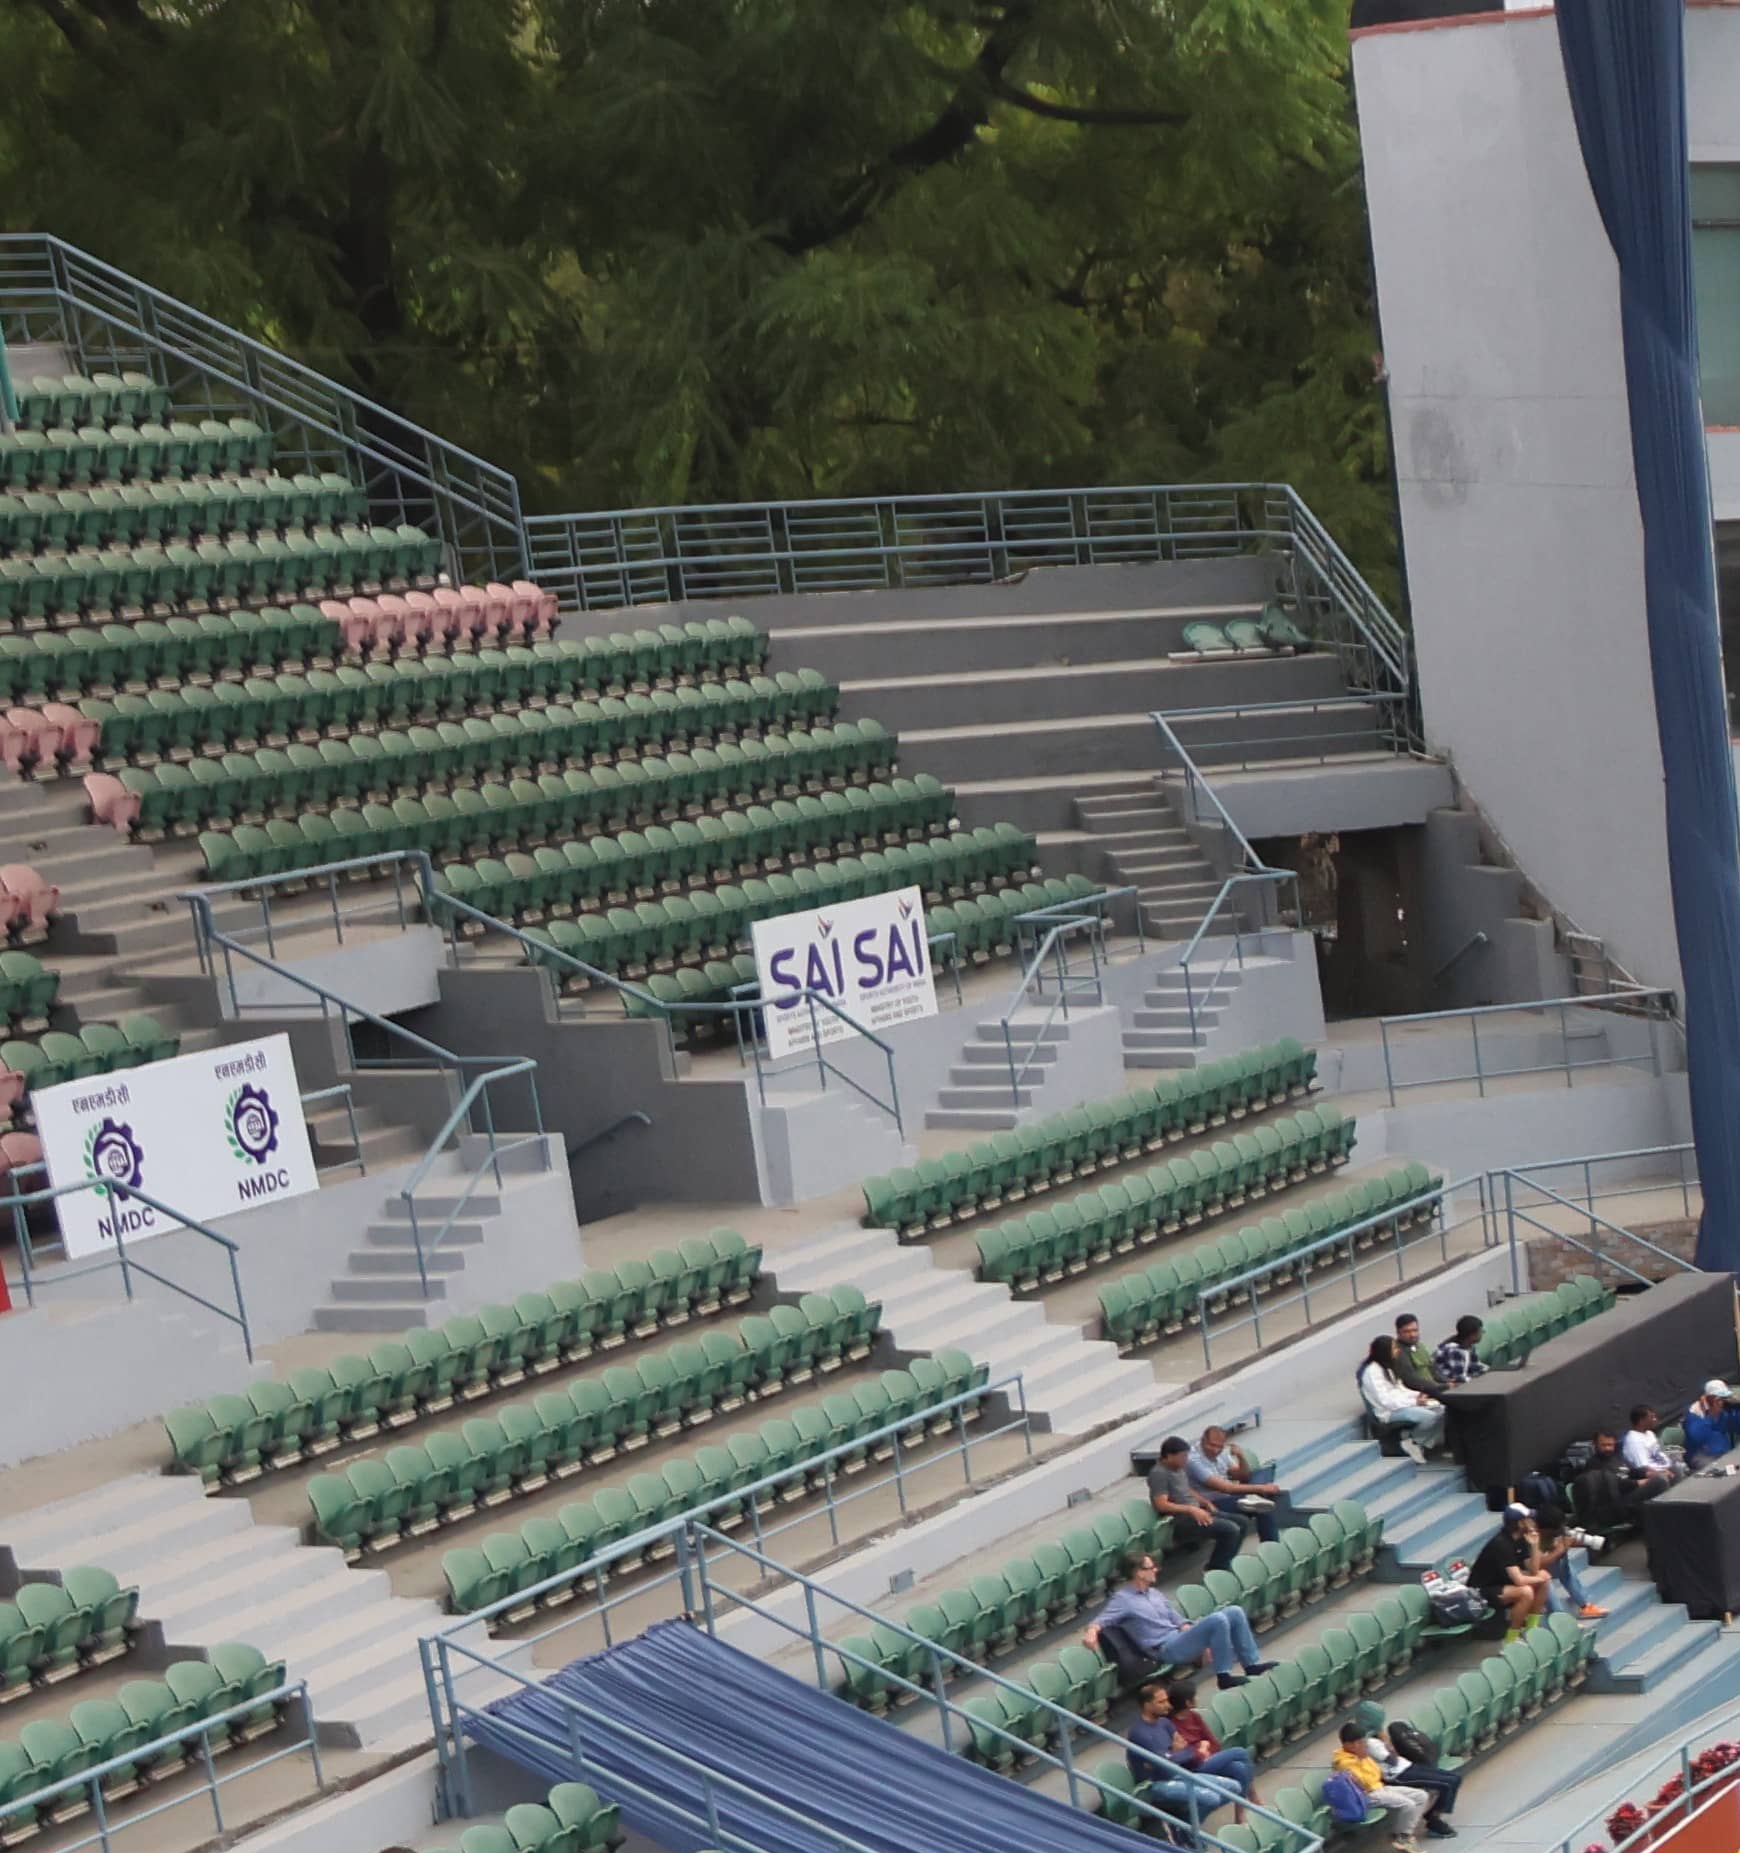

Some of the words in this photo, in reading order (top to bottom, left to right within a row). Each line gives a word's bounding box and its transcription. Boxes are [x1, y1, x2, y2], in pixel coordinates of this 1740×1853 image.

[770, 938, 844, 1009] SAI
[854, 919, 924, 988] SAI
[238, 1169, 290, 1200] NMDC
[98, 1207, 155, 1238] NMDC
